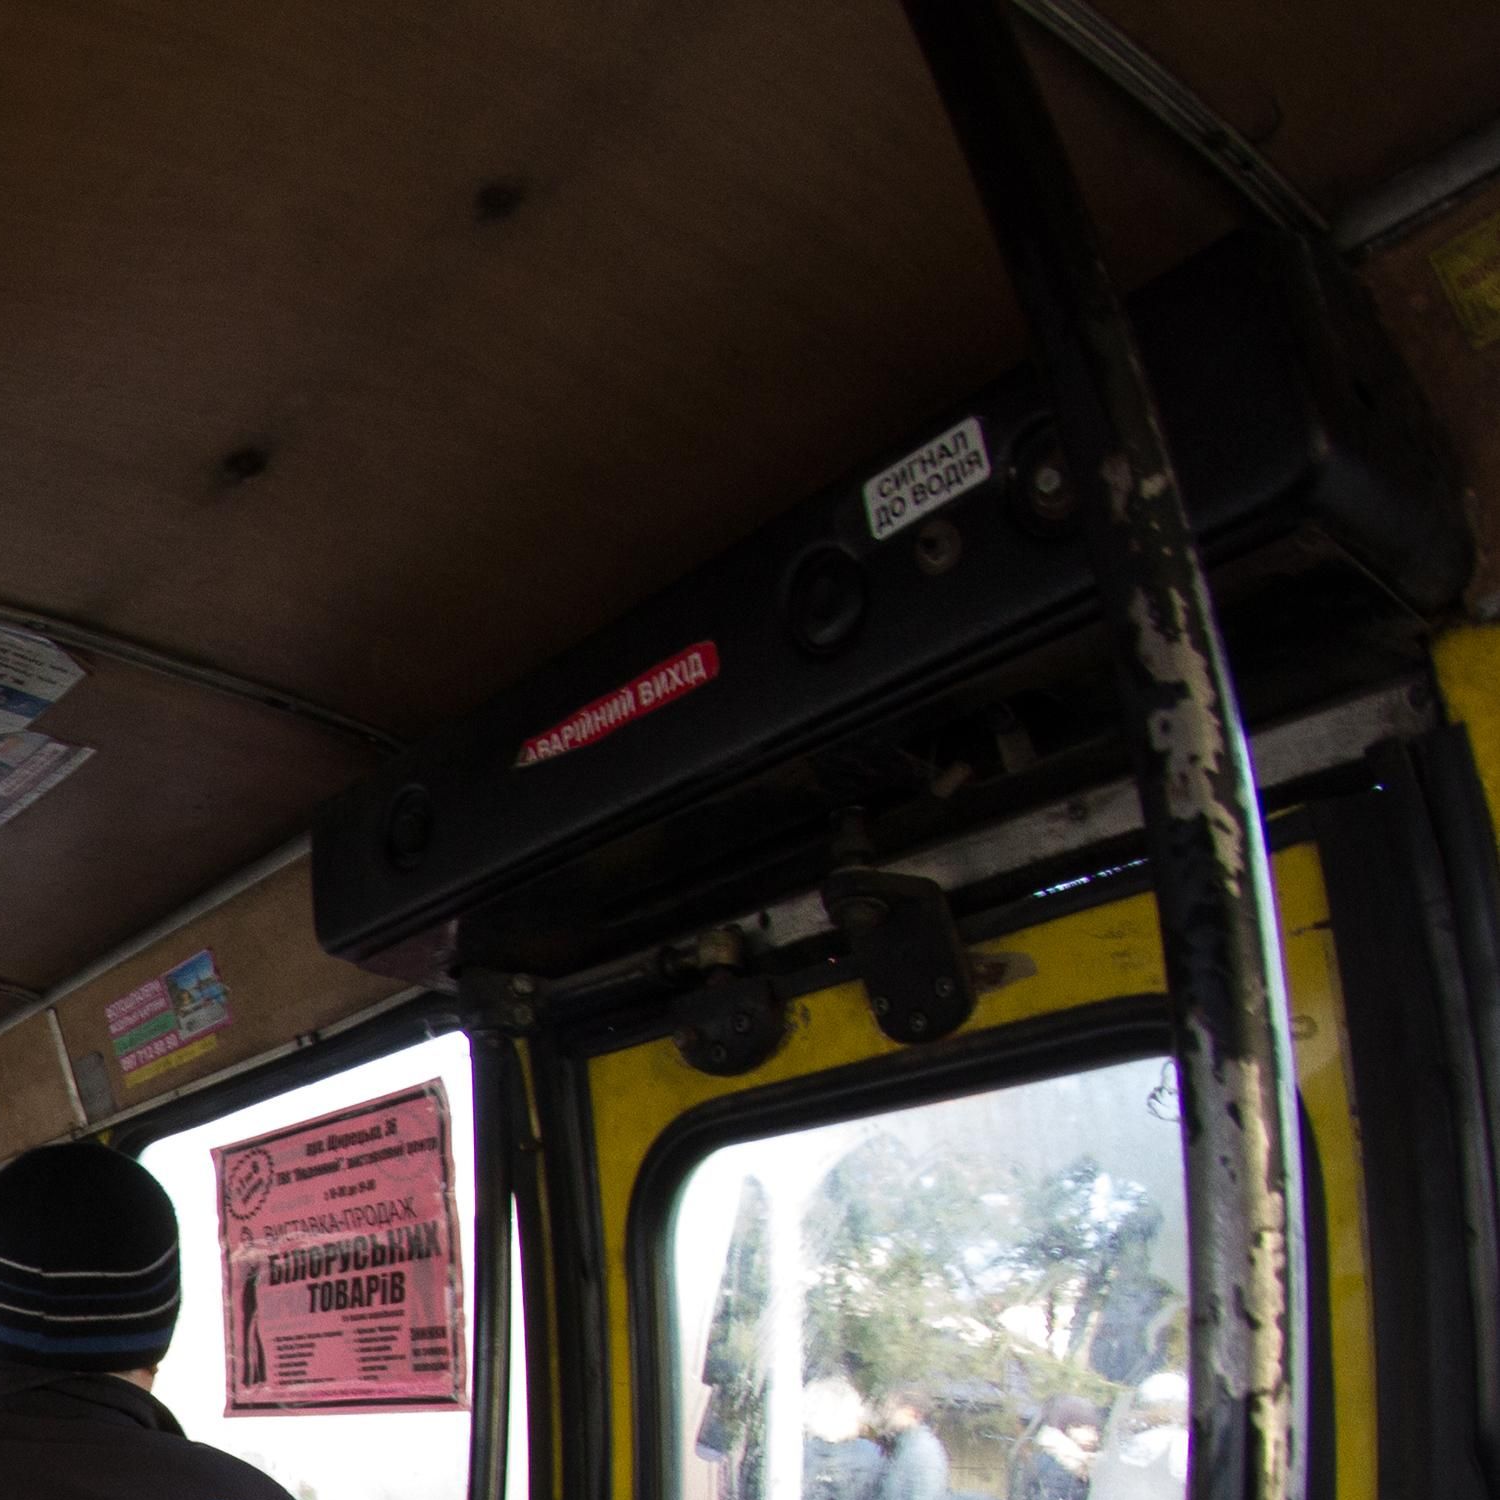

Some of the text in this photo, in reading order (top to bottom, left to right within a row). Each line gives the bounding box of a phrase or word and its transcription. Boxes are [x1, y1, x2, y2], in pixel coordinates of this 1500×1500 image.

[875, 449, 982, 533] ДО ВОДІЯ
[878, 430, 969, 498] СИГНАЛ
[525, 651, 707, 762] АВАРІЙНИЙ ВИХІД
[263, 1196, 417, 1243] ВИСТАВКА-ПРОДАЖ
